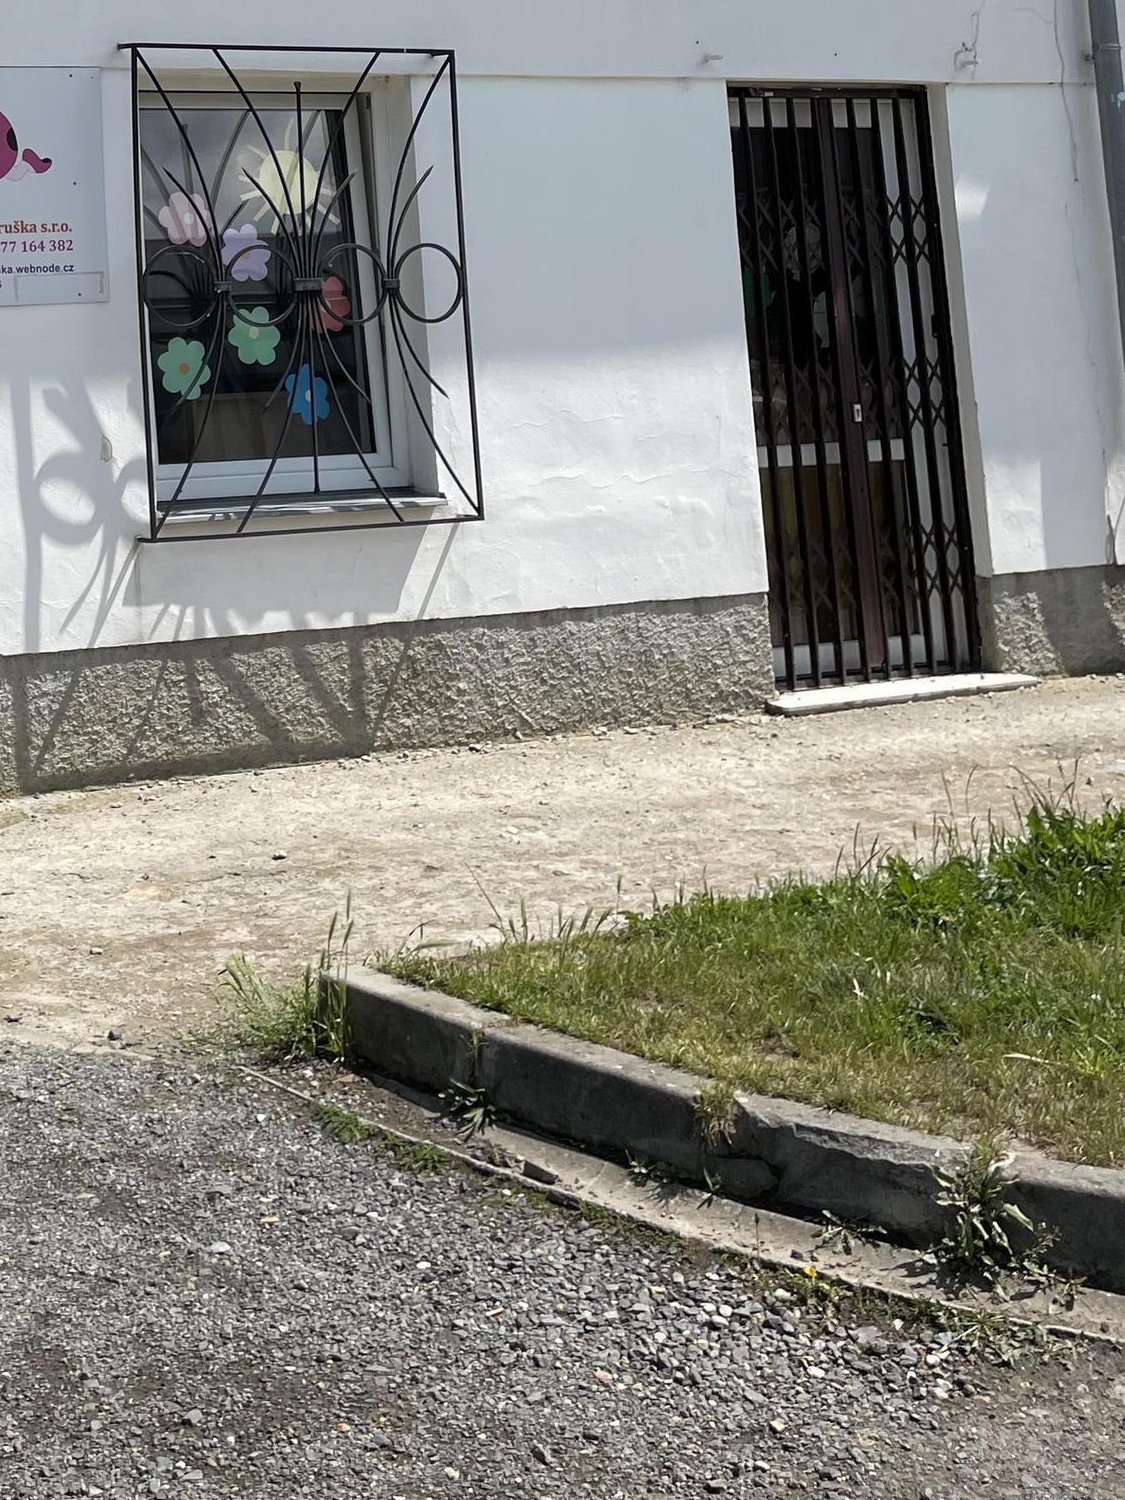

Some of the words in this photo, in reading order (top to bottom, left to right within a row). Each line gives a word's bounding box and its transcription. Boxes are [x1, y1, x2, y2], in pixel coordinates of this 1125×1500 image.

[40, 221, 73, 233] s.r.o.
[21, 240, 45, 253] 164
[48, 239, 74, 252] 382
